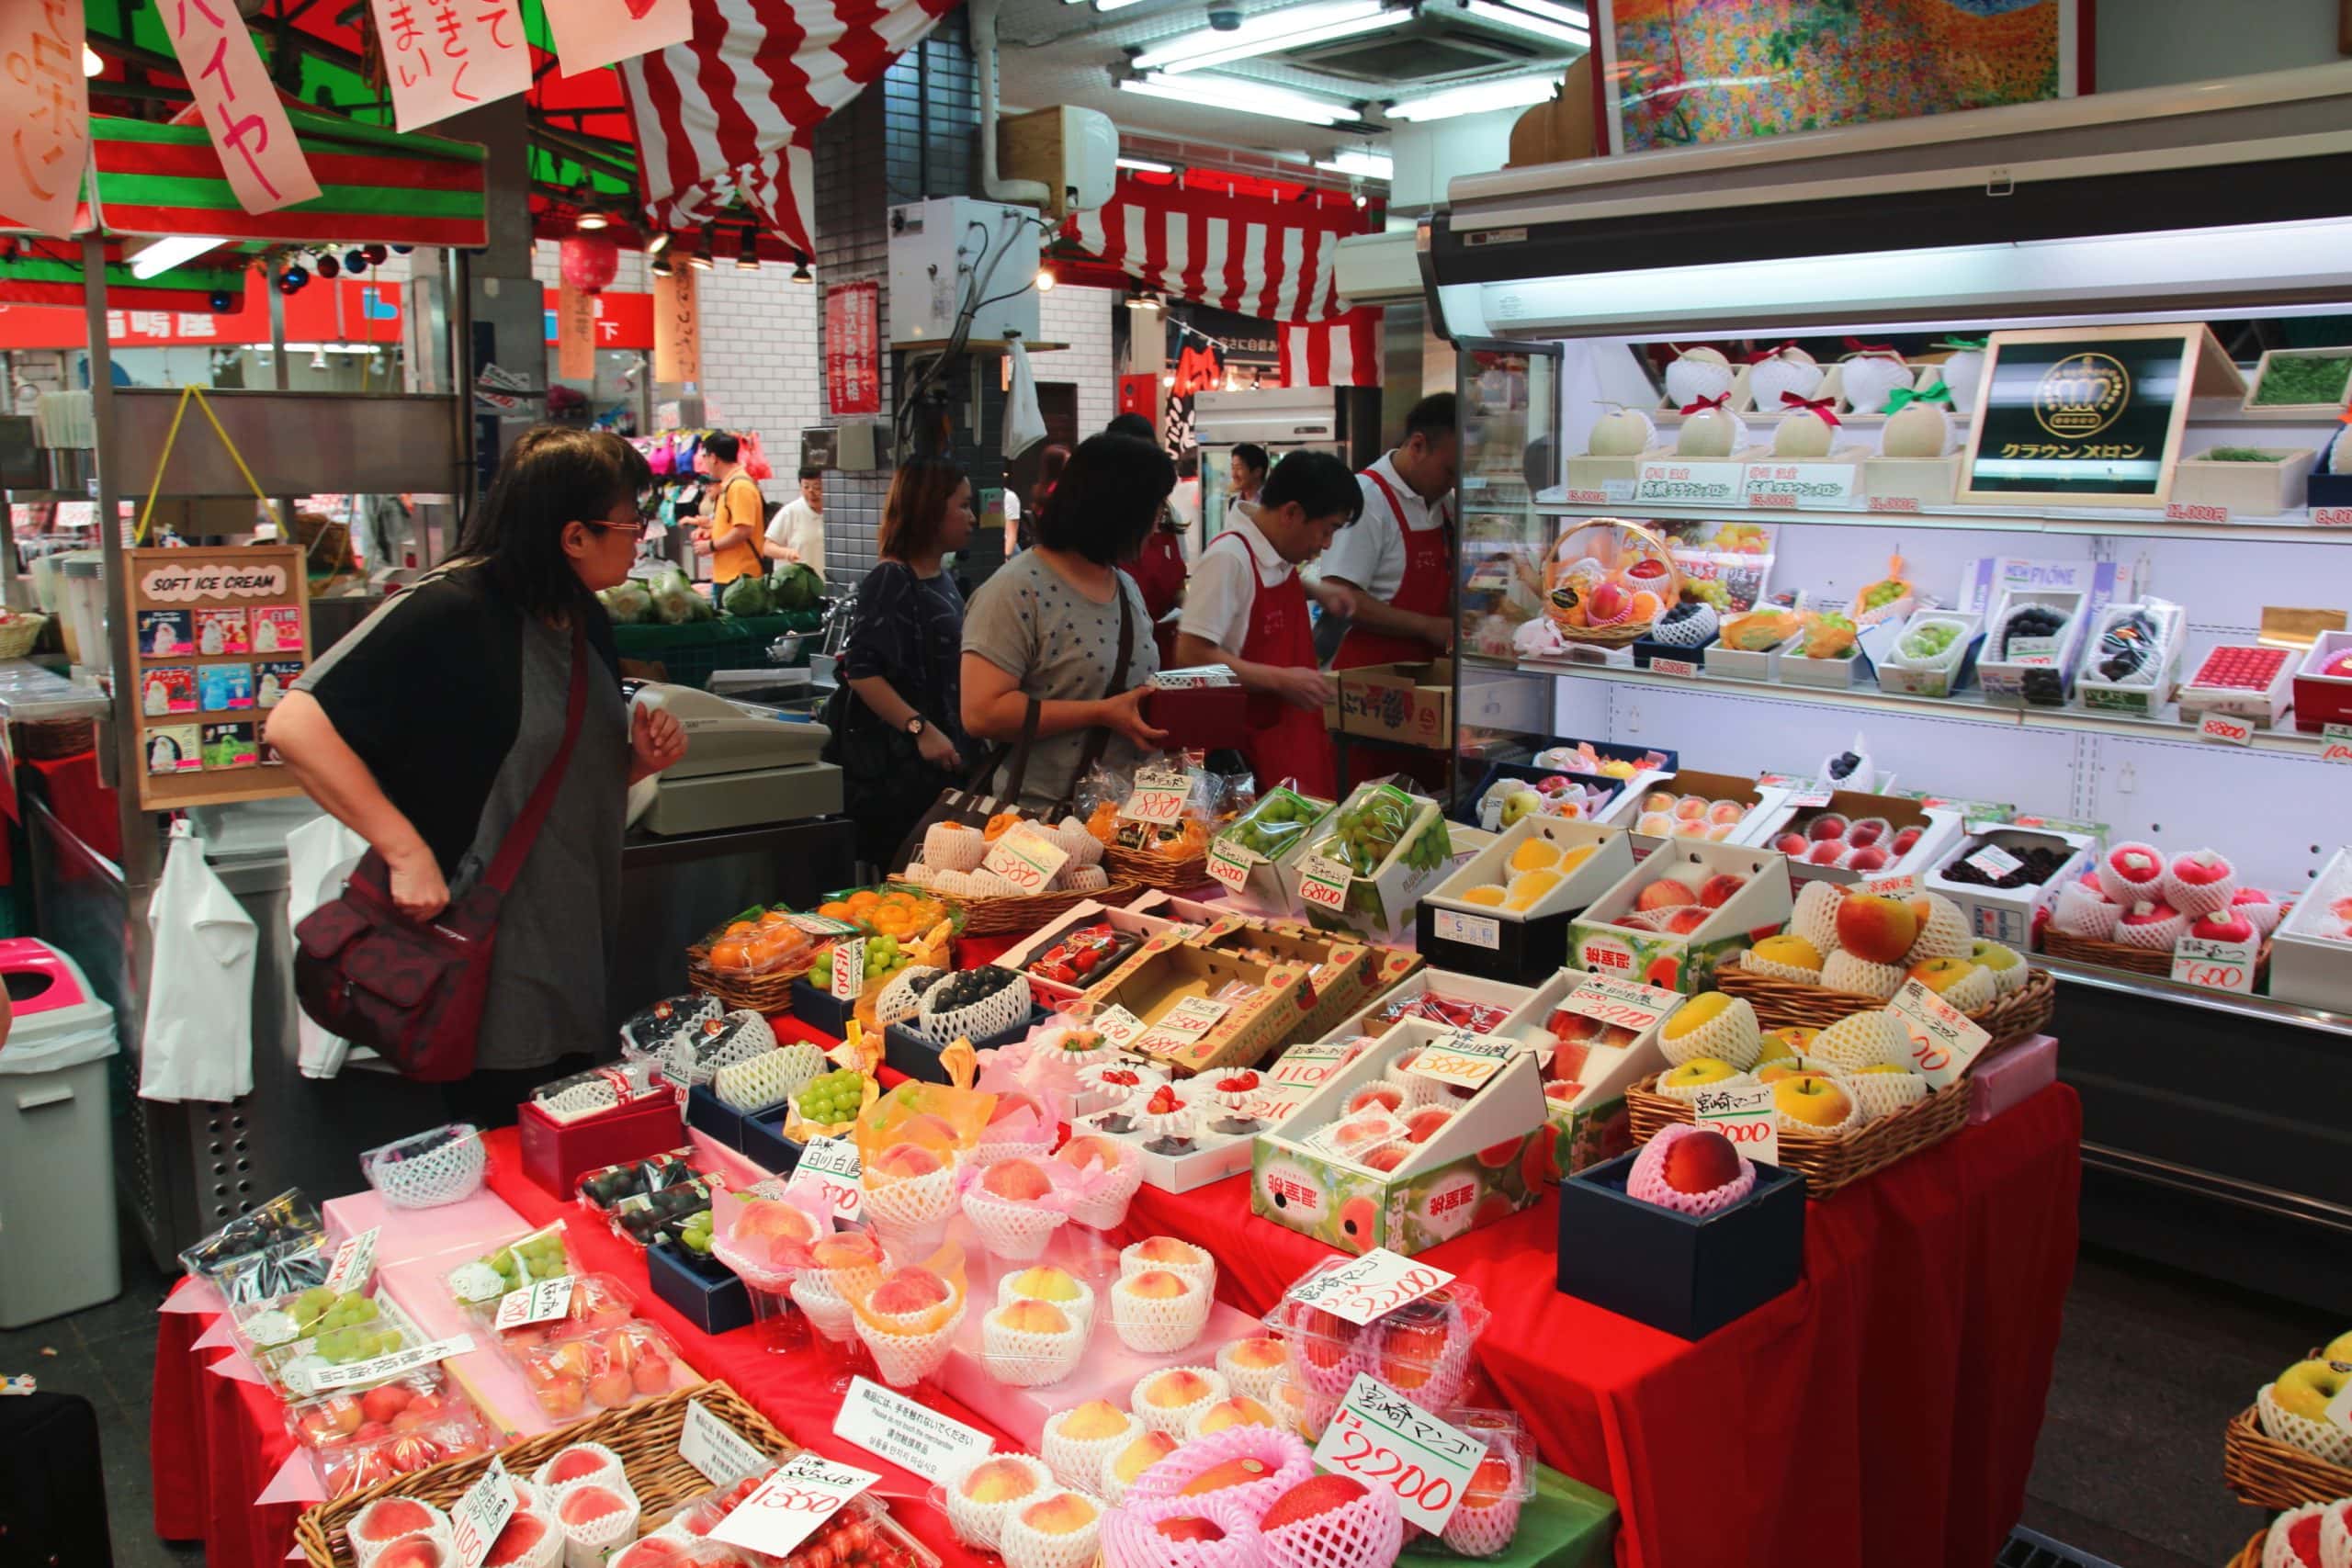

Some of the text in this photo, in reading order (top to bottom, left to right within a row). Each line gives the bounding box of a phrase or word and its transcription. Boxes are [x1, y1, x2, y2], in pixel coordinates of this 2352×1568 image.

[477, 0, 514, 49] て
[390, 0, 432, 87] まい
[430, 0, 481, 102] きく
[2000, 443, 2145, 459] クラウンメロン
[153, 574, 275, 592] SOFT ICE CREAM
[1134, 793, 1181, 818] 880
[994, 857, 1041, 888] 380
[1301, 880, 1341, 905] 6800
[1414, 1054, 1495, 1079] 3800
[1359, 1382, 1478, 1457] 宮崎マンゴ
[1331, 1429, 1453, 1512] 2200
